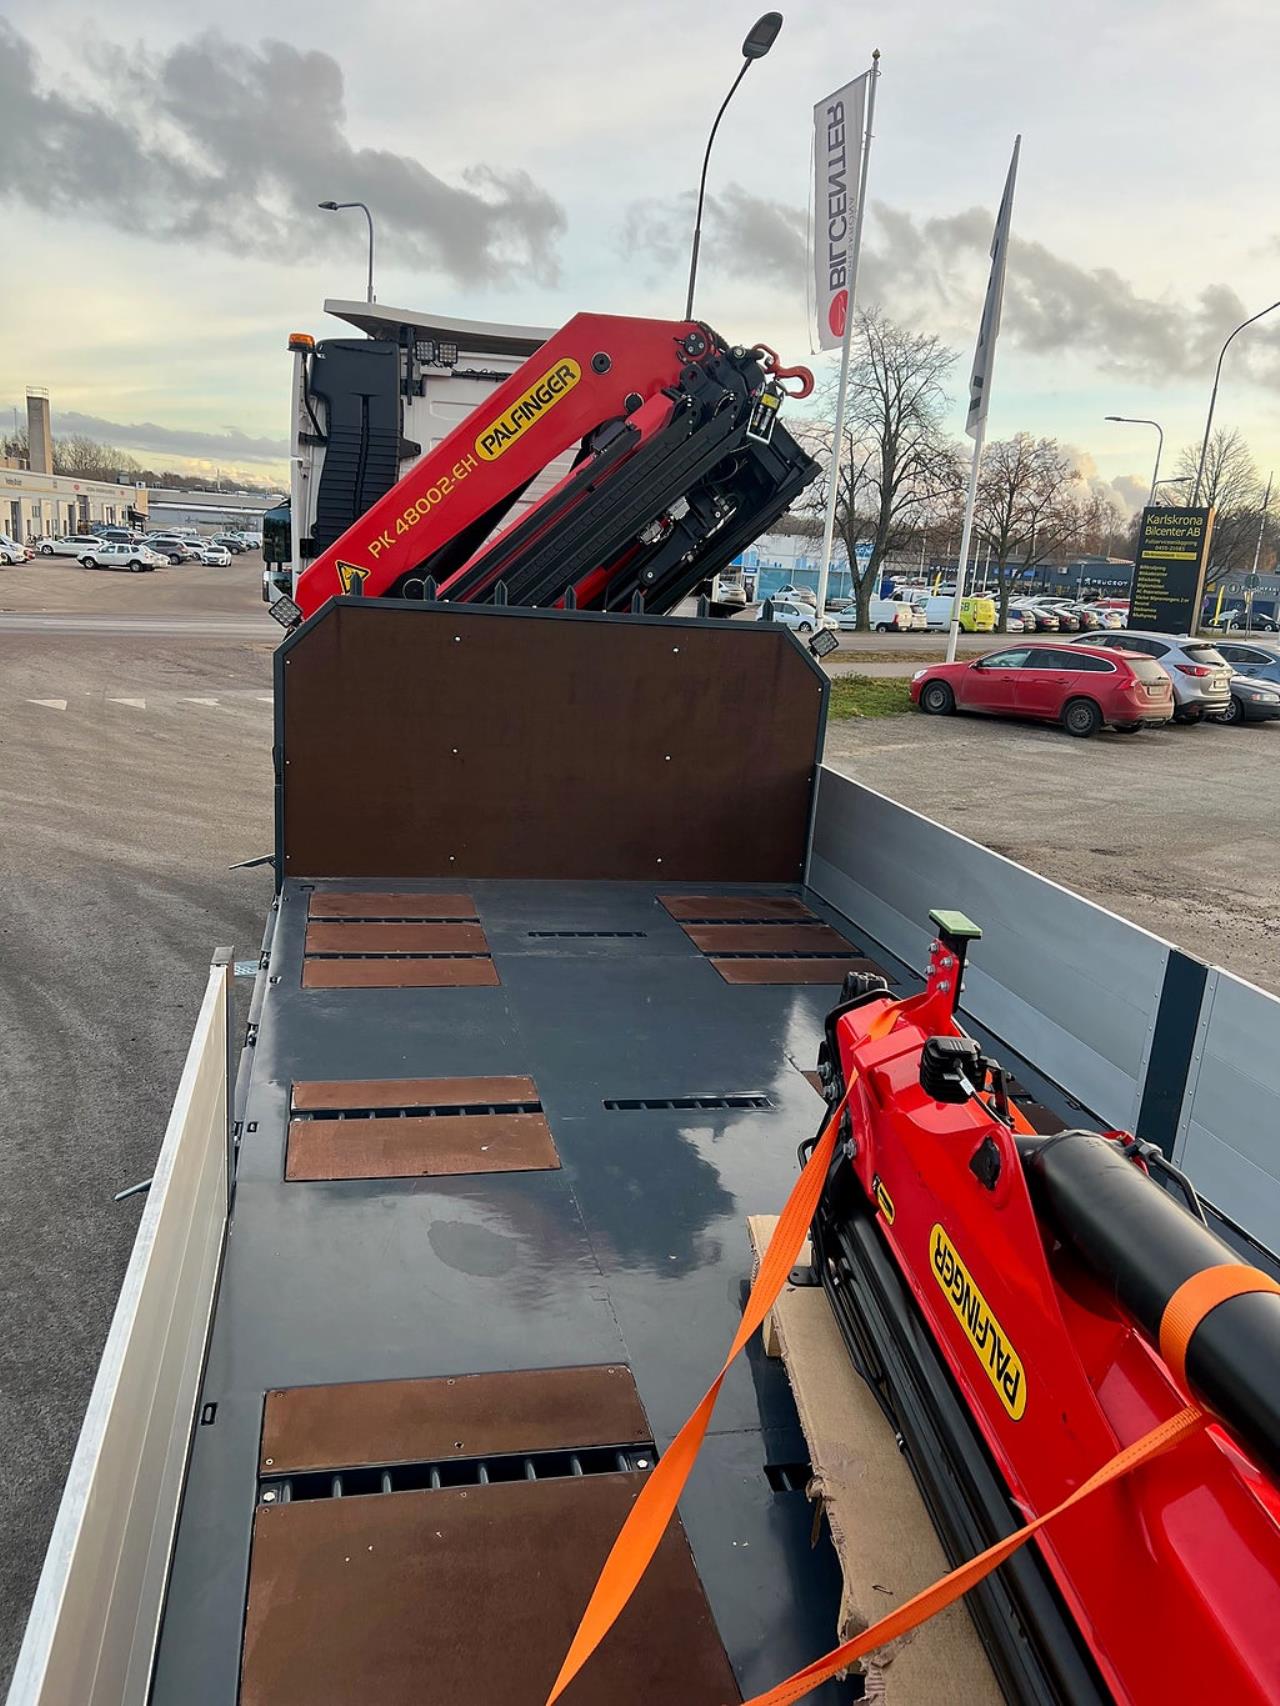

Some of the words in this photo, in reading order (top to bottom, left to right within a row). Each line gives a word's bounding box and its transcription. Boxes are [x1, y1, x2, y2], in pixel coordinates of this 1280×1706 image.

[480, 364, 577, 456] PALFINGER
[367, 530, 396, 559] PK
[395, 453, 479, 535] 48002-EH
[1145, 526, 1186, 537] Bilcenter
[1186, 527, 1201, 537] AB
[1146, 514, 1203, 526] Karlskrona
[1091, 578, 1128, 587] PEUGEOT
[934, 1232, 1021, 1409] PALFINGER
